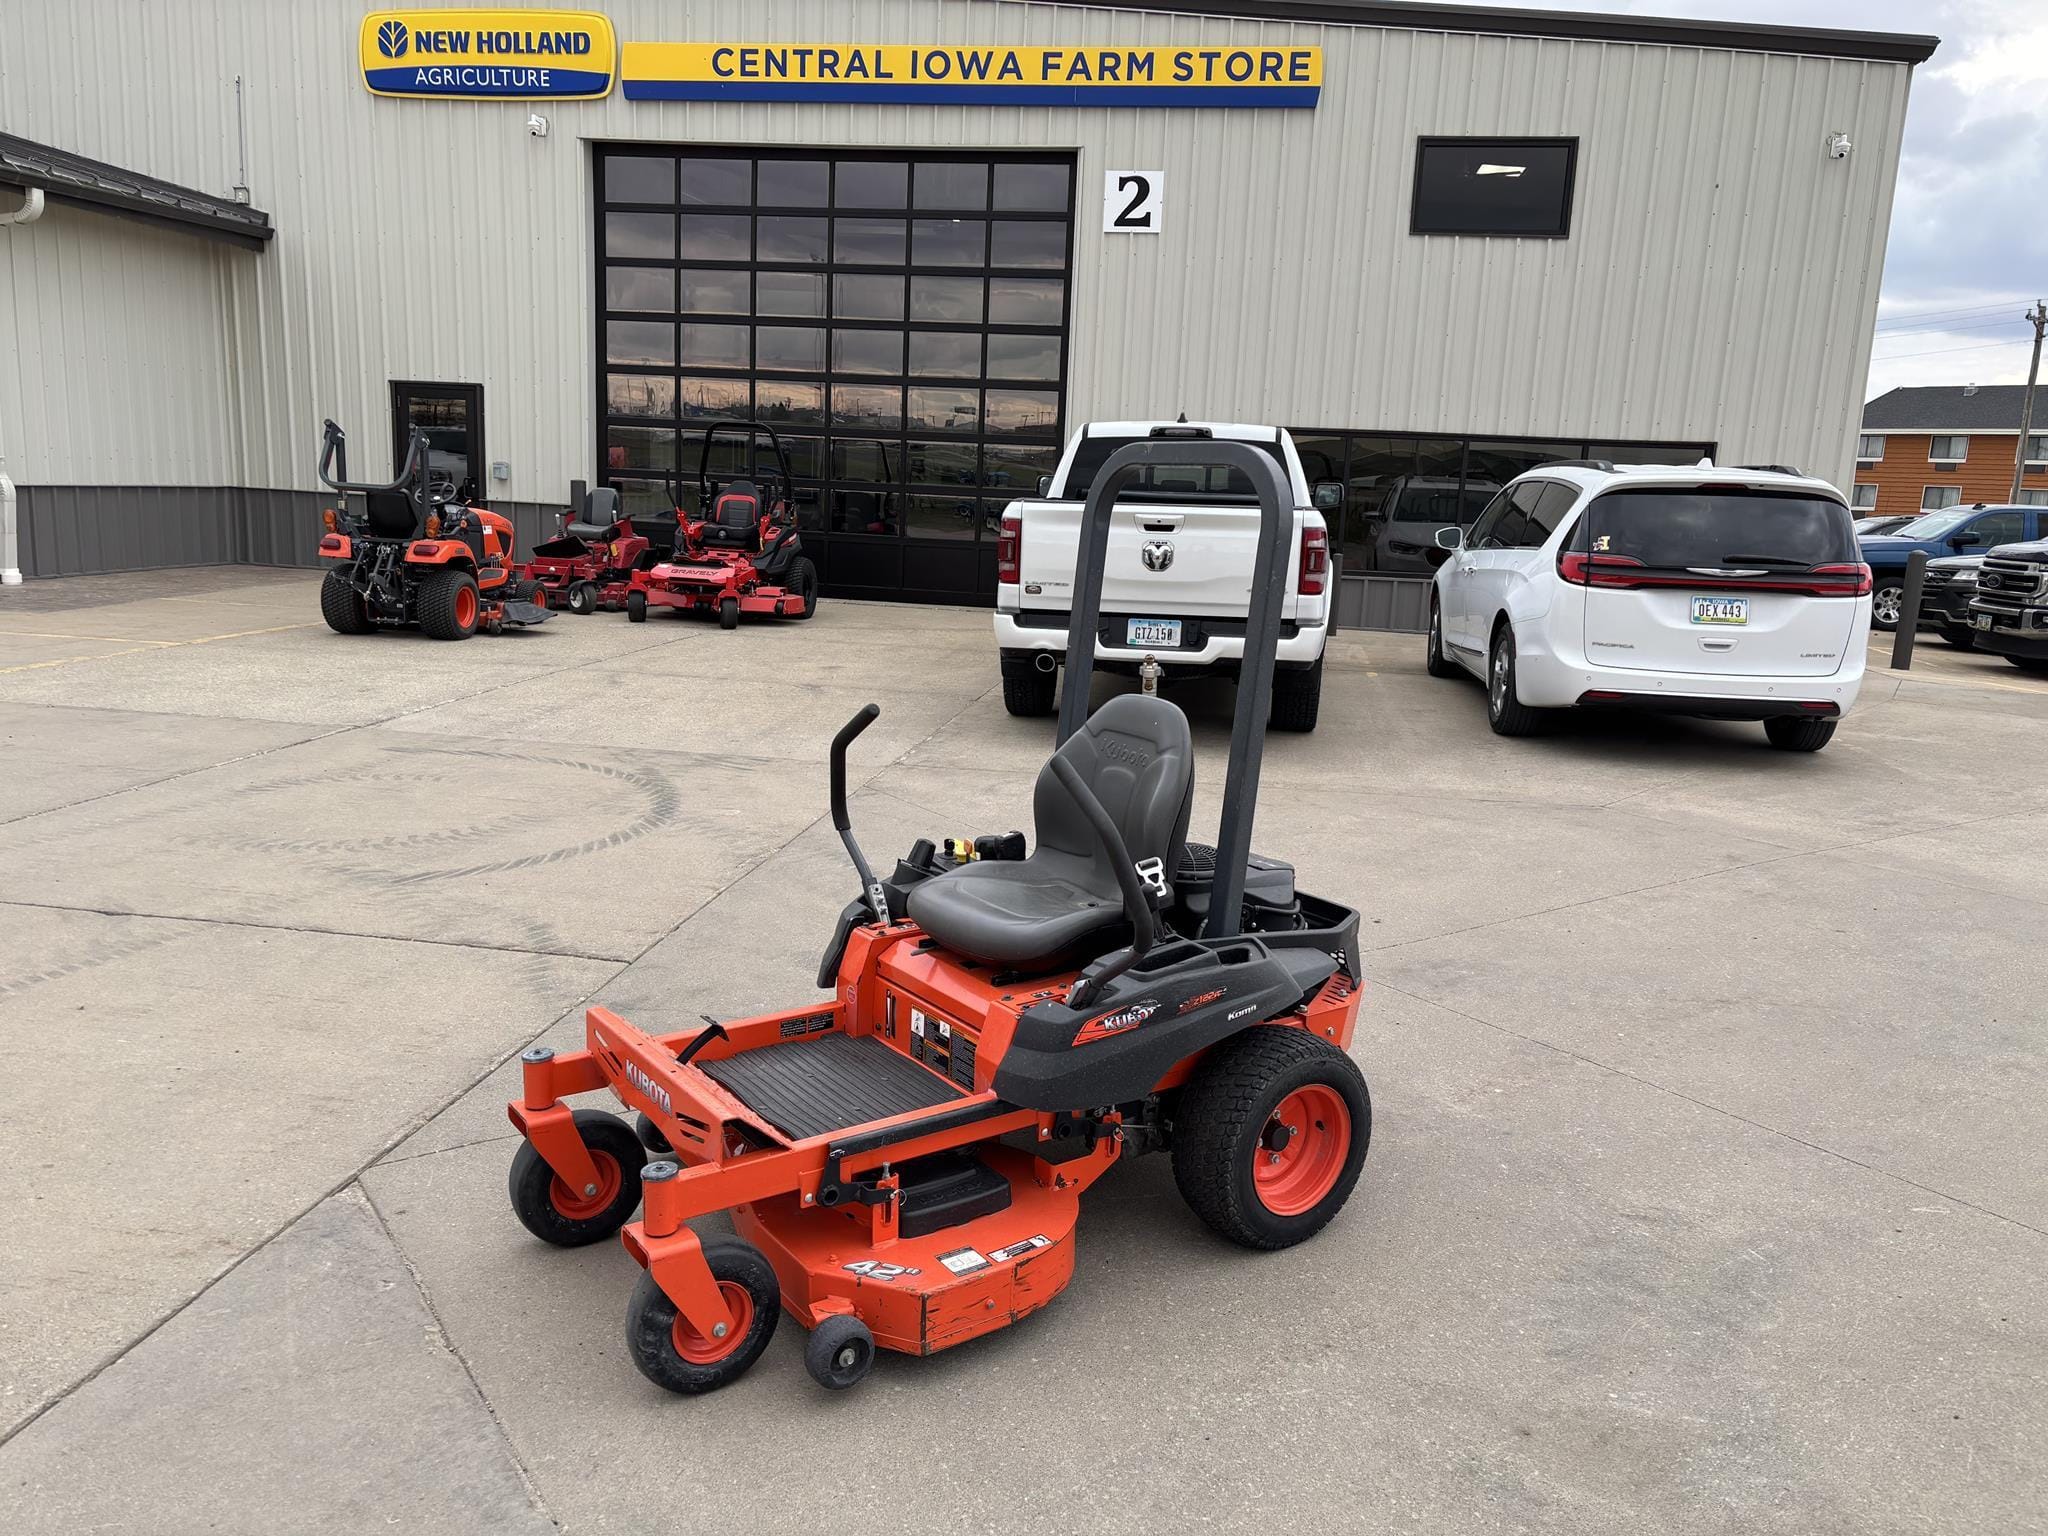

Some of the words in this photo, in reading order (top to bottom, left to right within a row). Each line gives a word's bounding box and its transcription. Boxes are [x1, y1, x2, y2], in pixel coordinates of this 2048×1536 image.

[415, 31, 470, 53] NEW
[476, 31, 591, 54] HOLLAND
[711, 48, 893, 79] CENTRAL
[911, 50, 1023, 80] IOWA
[1041, 51, 1155, 82] FARM
[1173, 51, 1311, 82] STORE
[415, 68, 550, 87] AGRICULTURE
[1113, 175, 1152, 228] 2
[1722, 605, 1741, 617] 443
[1156, 628, 1173, 640] 150
[626, 1059, 672, 1117] KUBOTA
